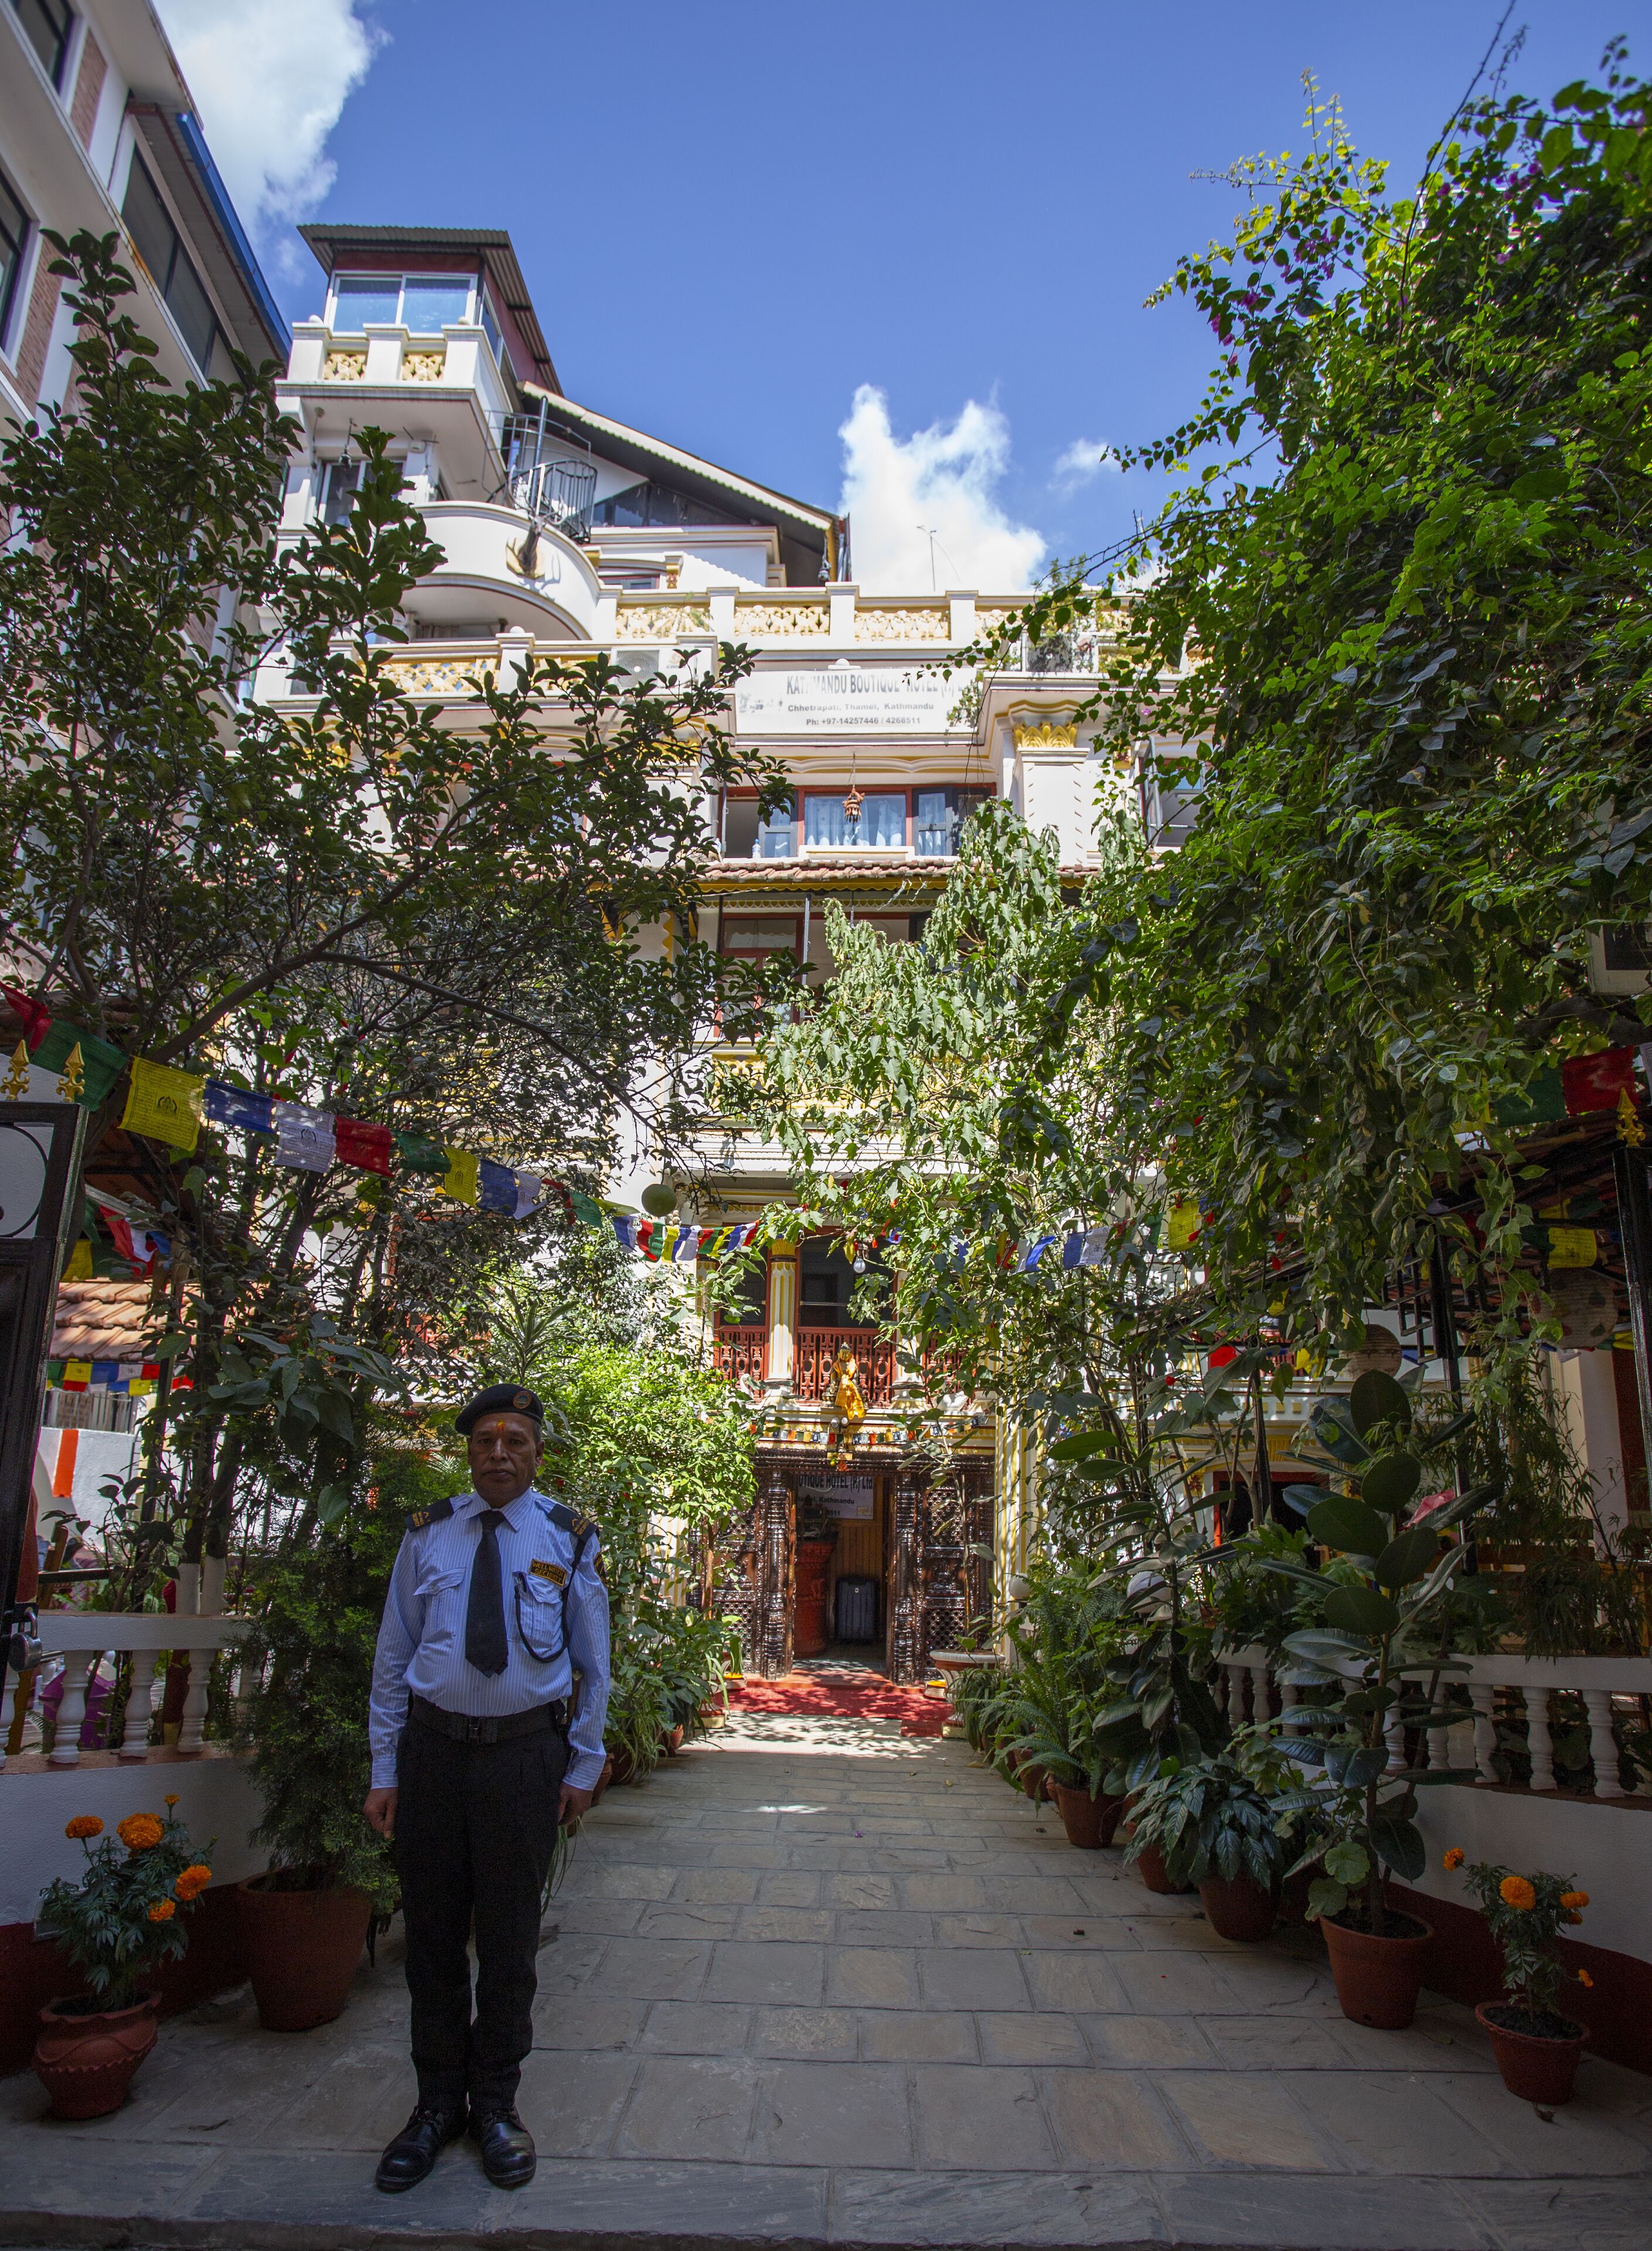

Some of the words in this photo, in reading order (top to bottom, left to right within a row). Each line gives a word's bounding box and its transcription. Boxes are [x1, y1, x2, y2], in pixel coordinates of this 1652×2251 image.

[850, 674, 900, 694] BOUTIQUE
[826, 1475, 849, 1489] HOTEL
[533, 1560, 547, 1570] WELL
[534, 1568, 562, 1583] SECURITY
